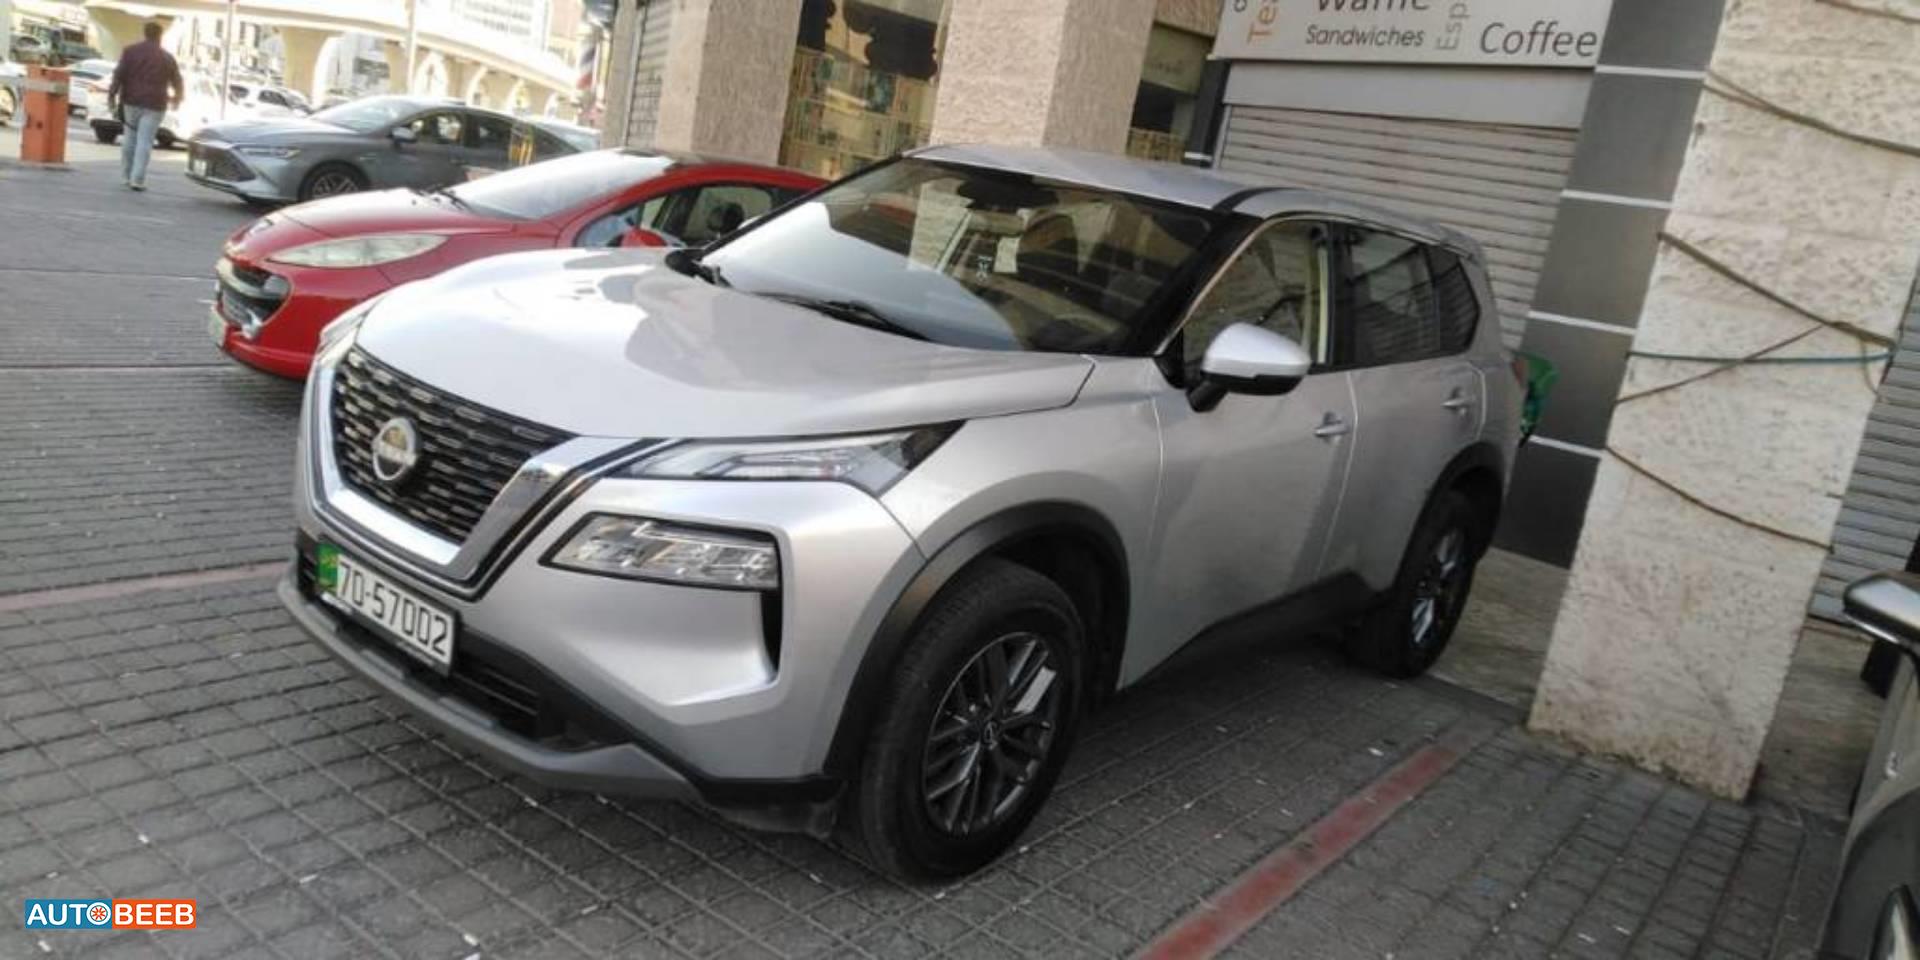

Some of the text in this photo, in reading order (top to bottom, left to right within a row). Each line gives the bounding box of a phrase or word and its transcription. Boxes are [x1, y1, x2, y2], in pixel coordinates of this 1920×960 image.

[1246, 0, 1278, 45] Te
[1305, 24, 1425, 47] Sandwiches
[1480, 20, 1598, 57] Coffee
[339, 560, 448, 656] 70-57002
